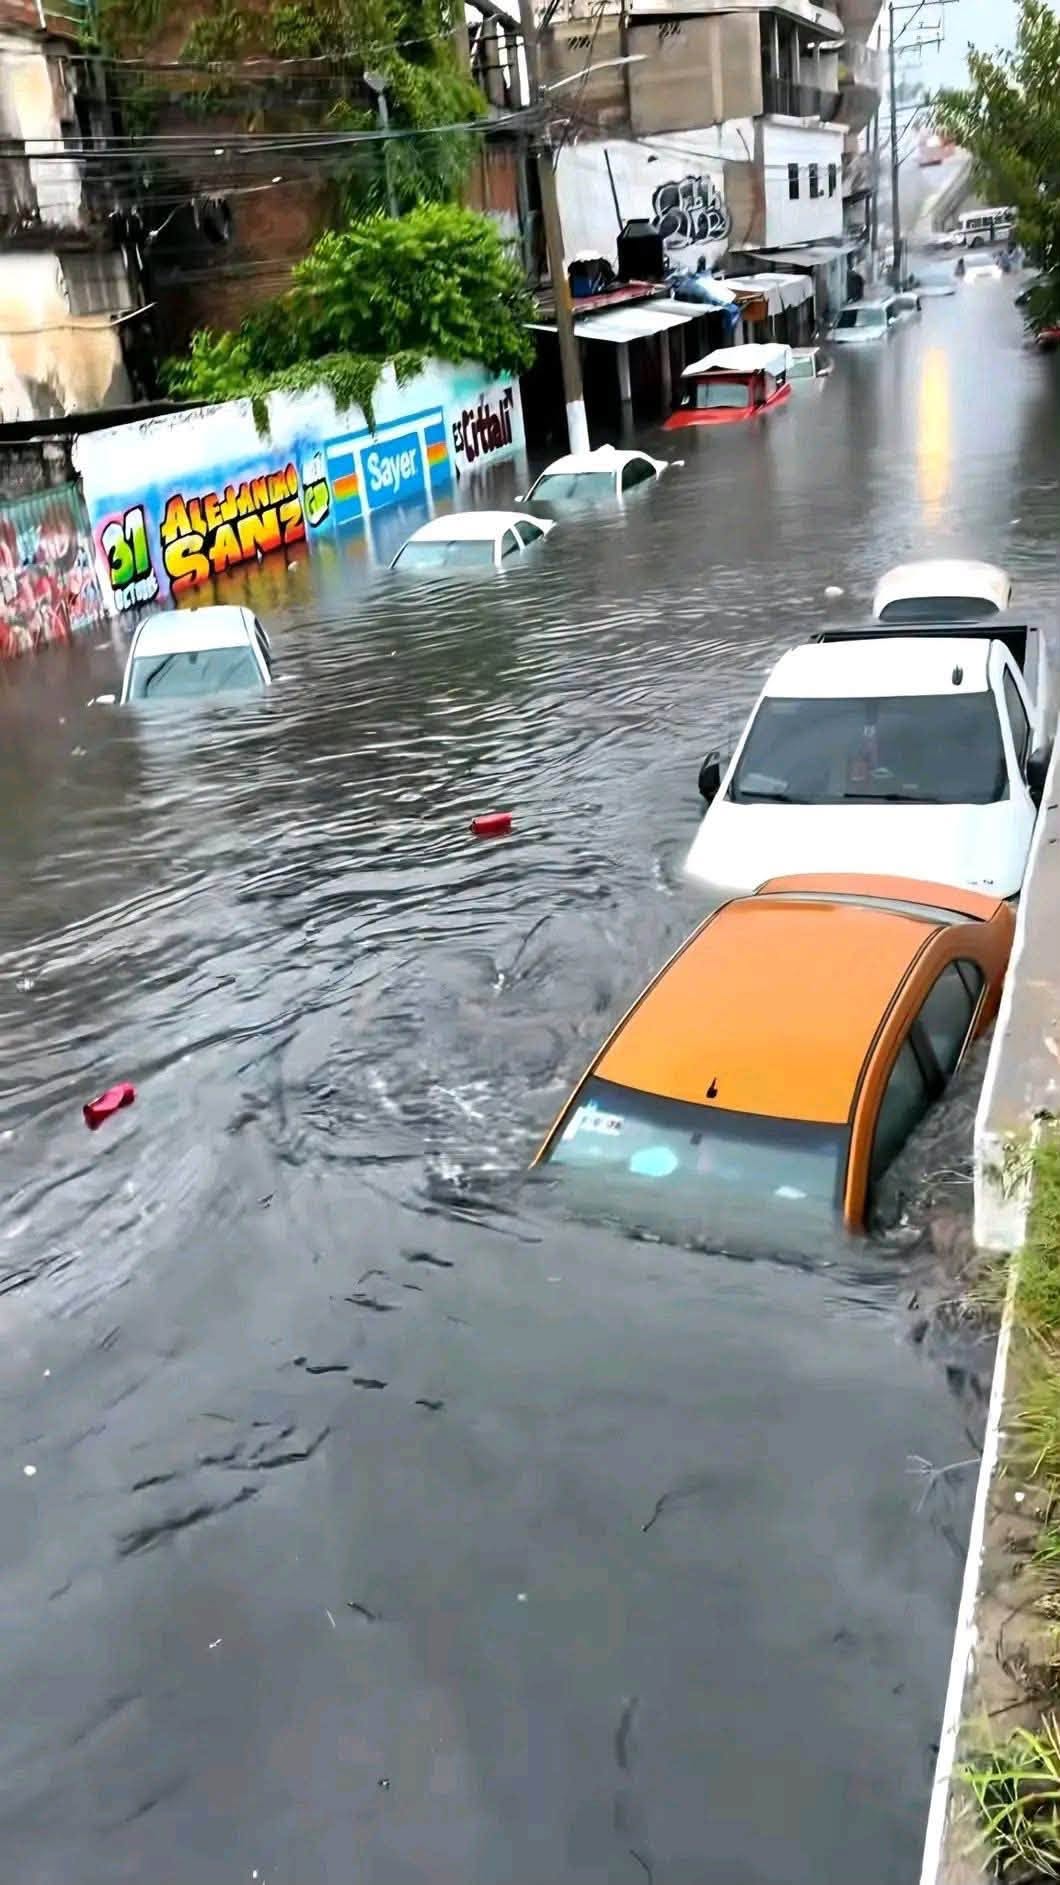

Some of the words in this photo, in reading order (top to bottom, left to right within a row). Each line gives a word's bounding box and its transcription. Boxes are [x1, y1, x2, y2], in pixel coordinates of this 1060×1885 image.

[160, 462, 299, 543] ALEJANDRO
[367, 448, 417, 494] Sayer
[101, 504, 151, 589] 31
[163, 498, 305, 594] SANZ
